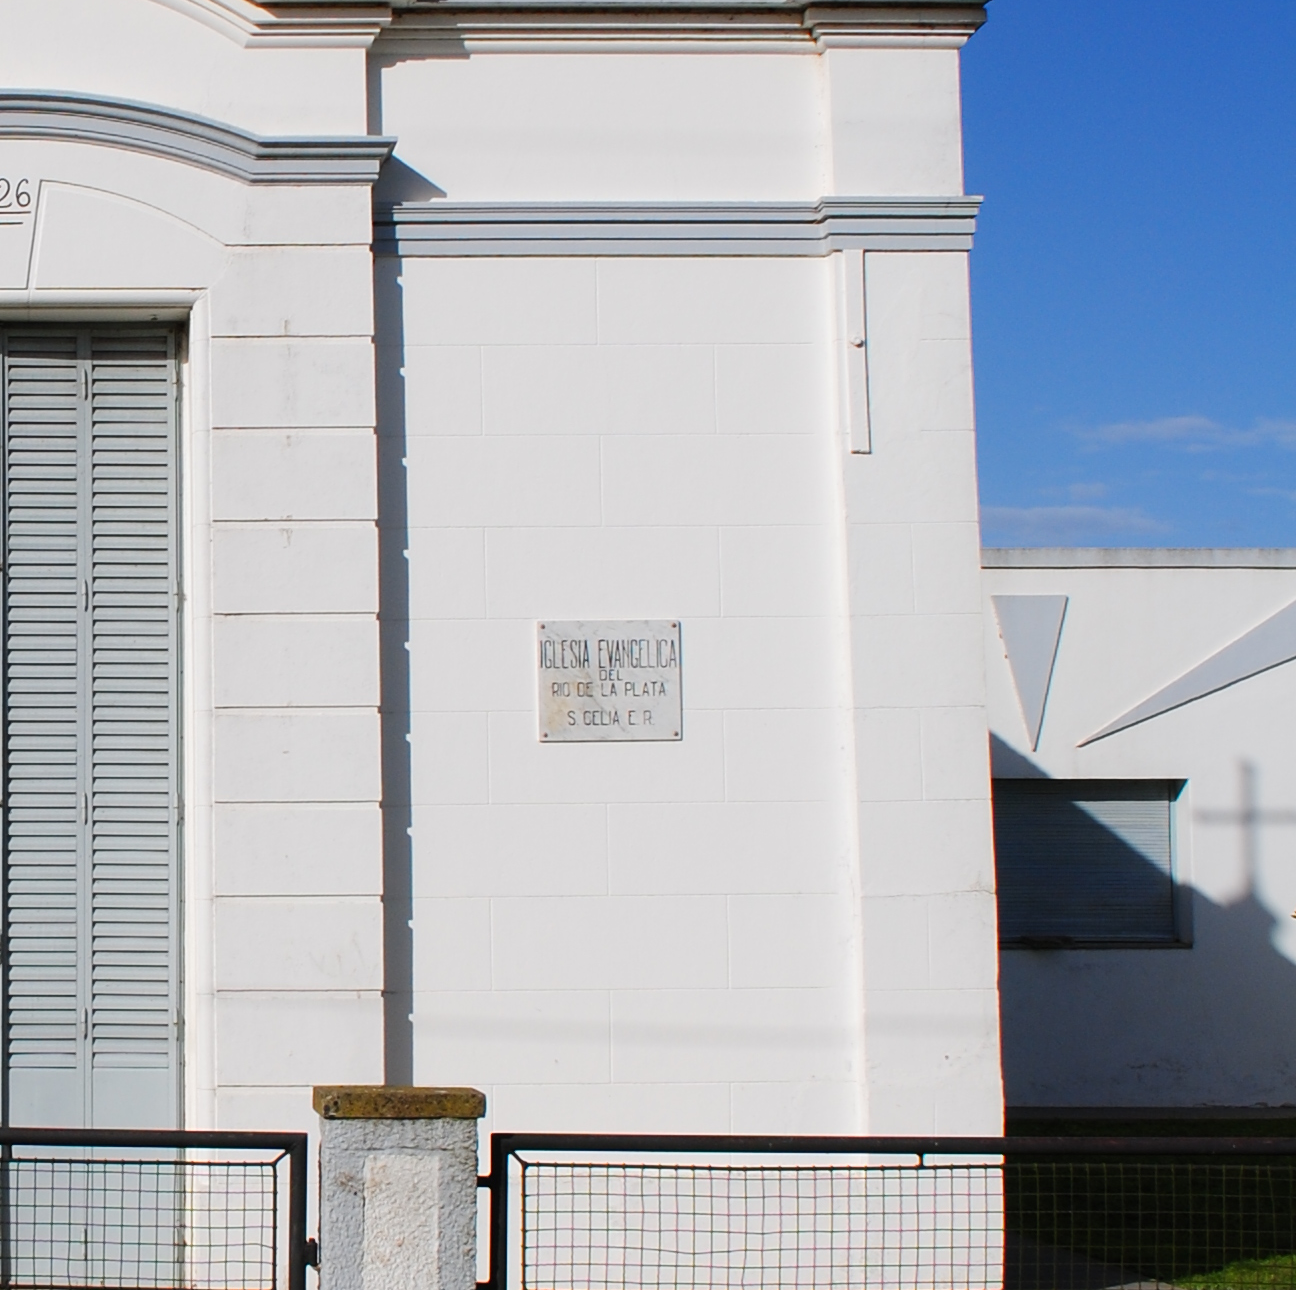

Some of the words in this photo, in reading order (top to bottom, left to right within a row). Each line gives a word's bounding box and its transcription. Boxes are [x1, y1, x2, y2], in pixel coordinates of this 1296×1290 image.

[540, 639, 590, 669] IGLESIA
[598, 639, 677, 669] EVANGELICA
[599, 669, 623, 681] DEL
[552, 682, 570, 697] RIO
[577, 682, 593, 697] DE
[601, 682, 617, 697] LA
[625, 682, 667, 697] PLATA
